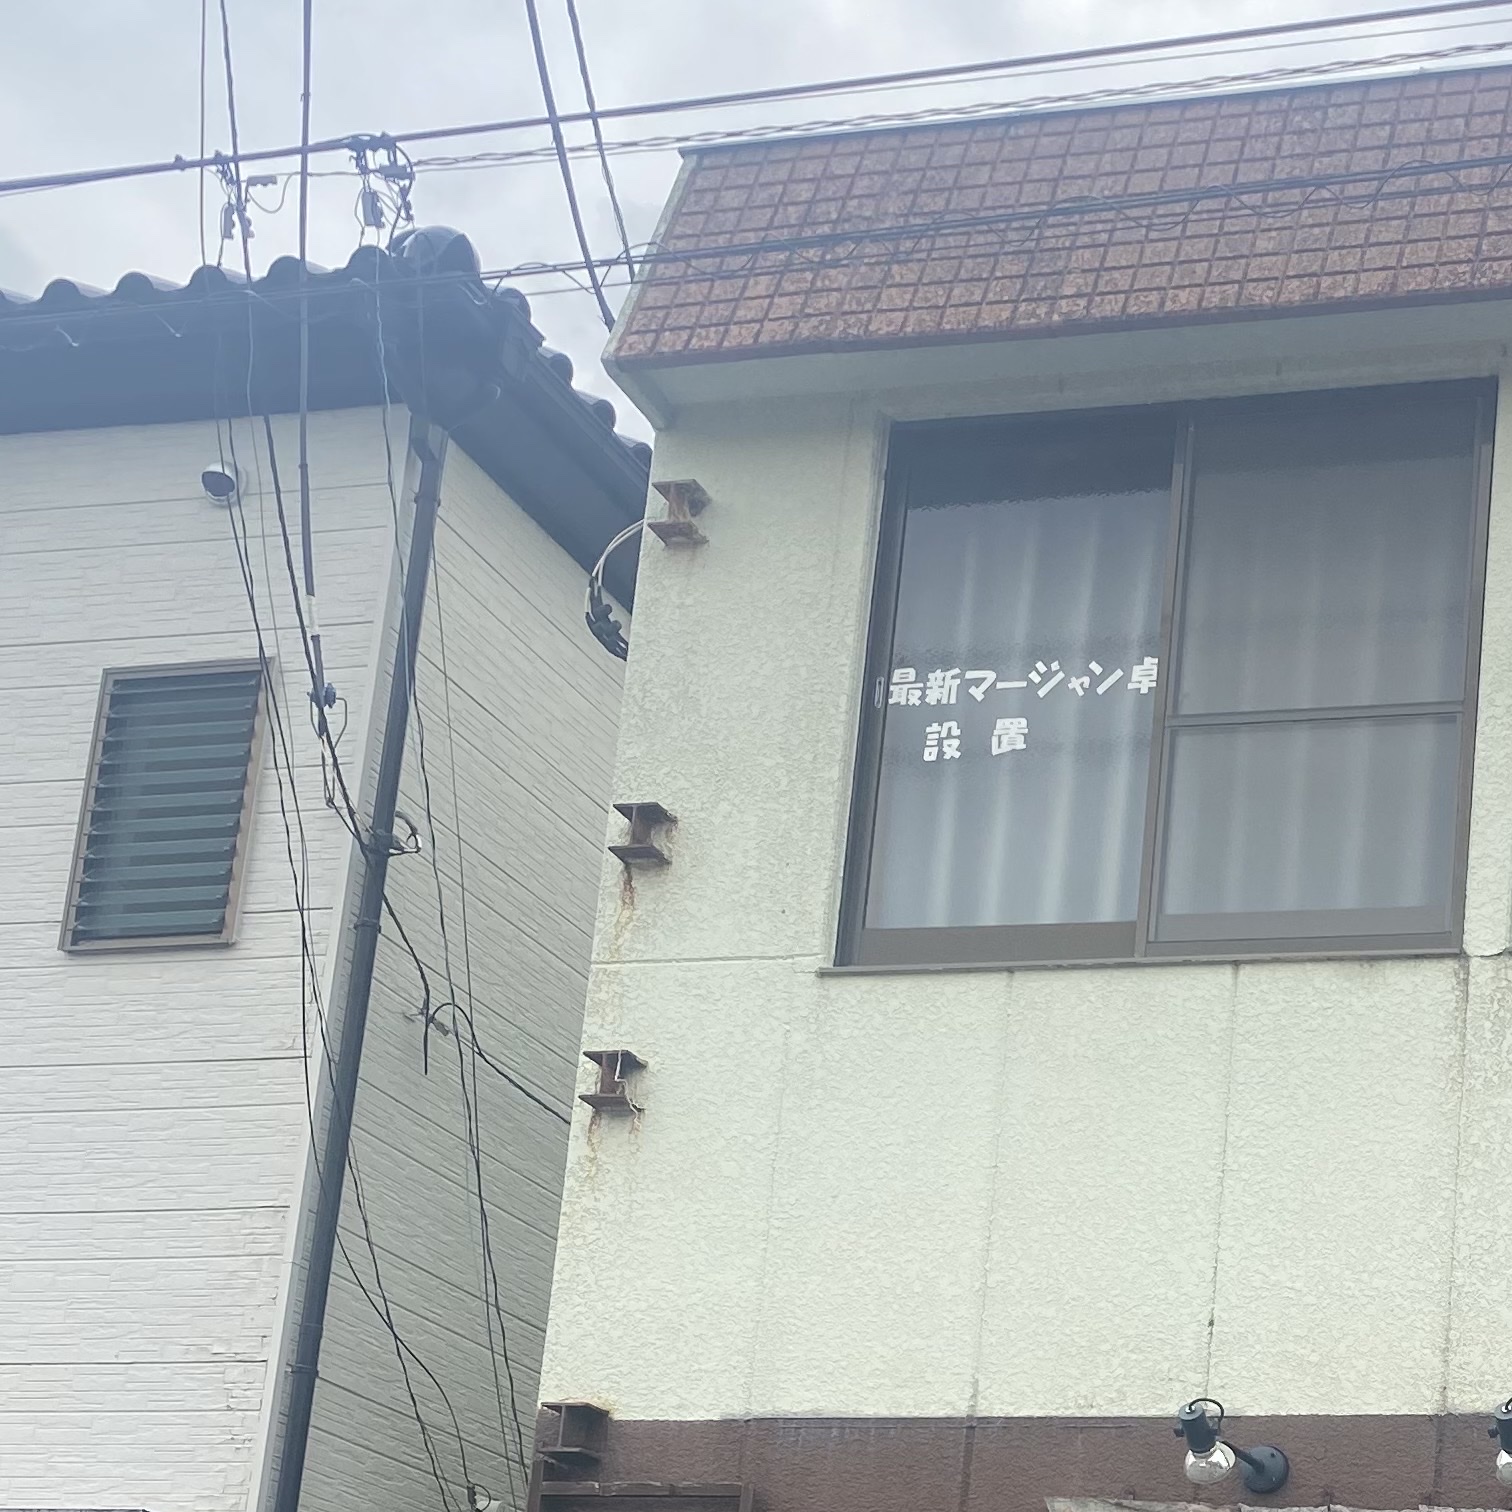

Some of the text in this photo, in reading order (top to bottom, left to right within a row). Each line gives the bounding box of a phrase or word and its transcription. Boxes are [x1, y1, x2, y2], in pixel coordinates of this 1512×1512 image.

[889, 656, 1159, 706] 最新マージャン卓
[923, 717, 1029, 762] 設置
